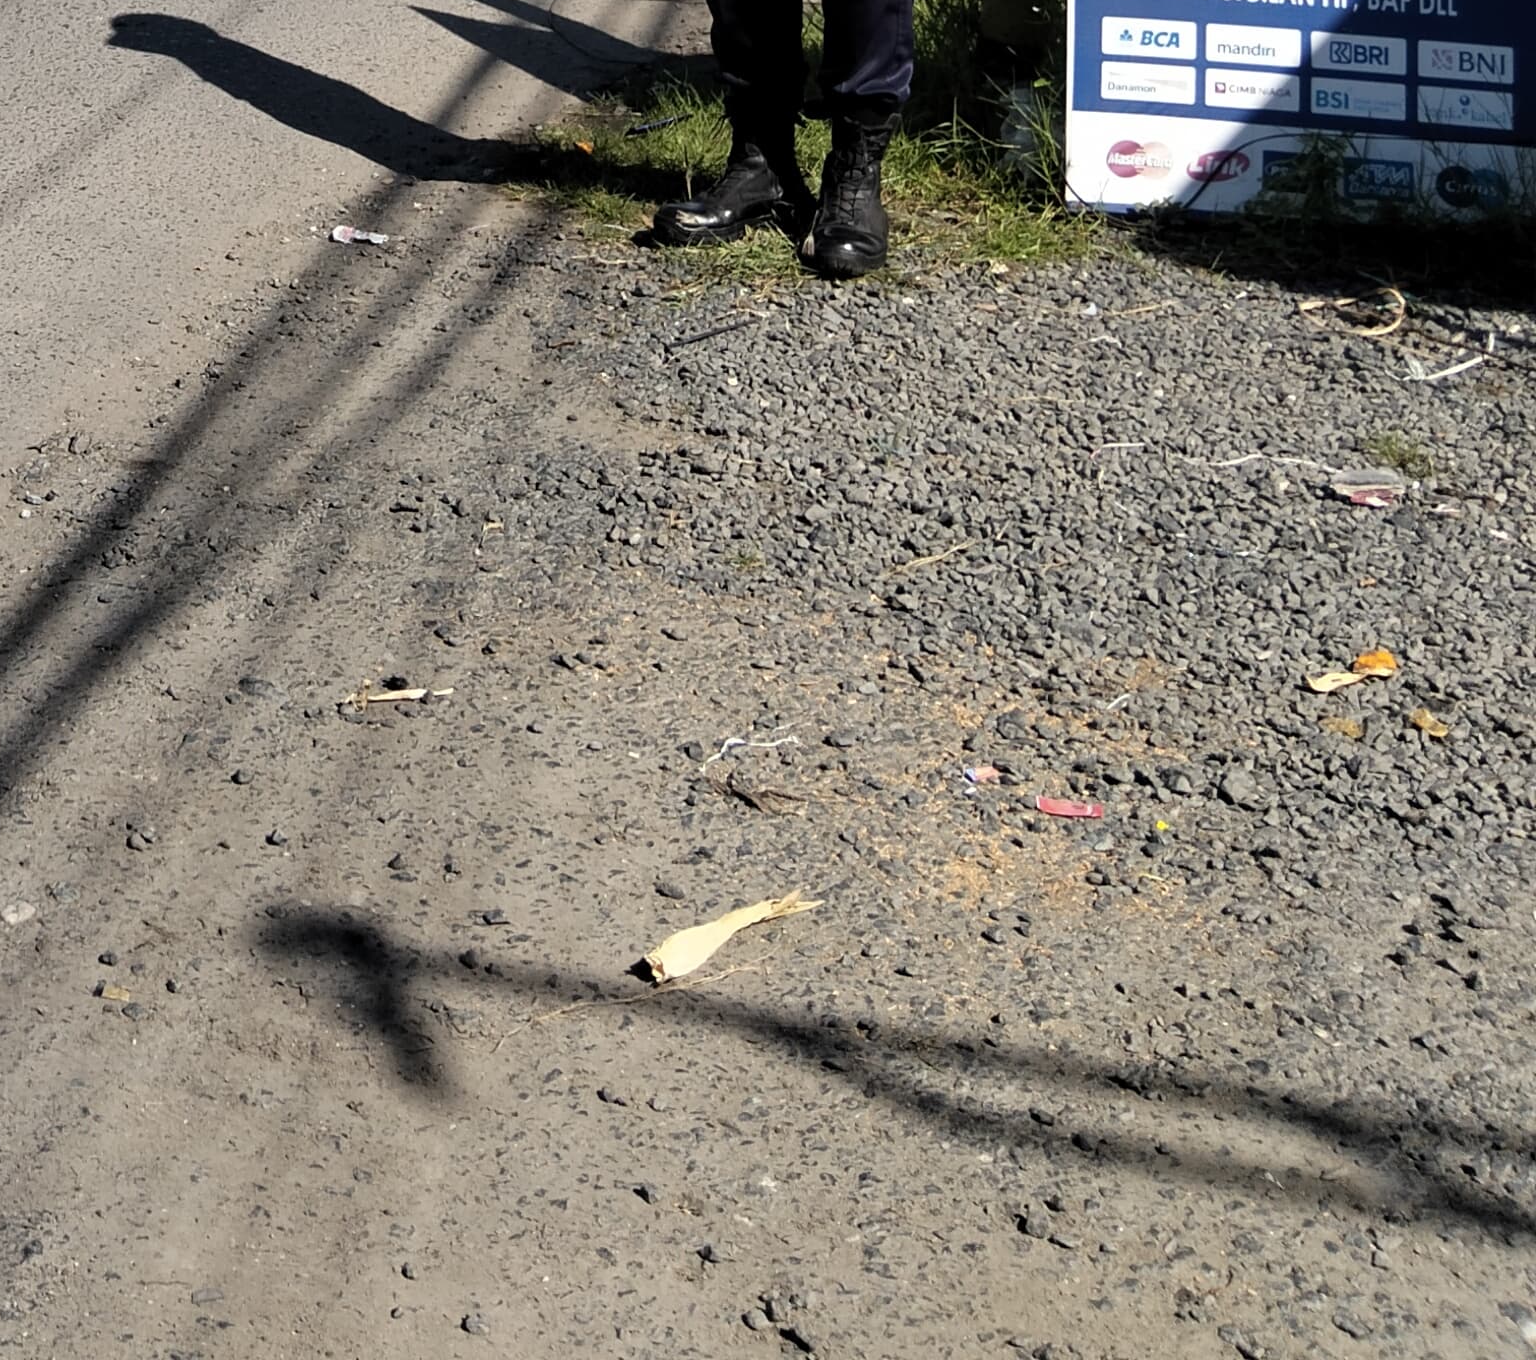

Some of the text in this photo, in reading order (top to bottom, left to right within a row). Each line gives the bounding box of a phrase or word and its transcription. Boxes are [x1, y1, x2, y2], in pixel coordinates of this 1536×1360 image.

[1140, 30, 1181, 49] BCA
[1217, 42, 1276, 58] mandiri
[1353, 45, 1389, 66] BRI
[1458, 51, 1506, 76] BNI
[1107, 82, 1156, 94] Danamon
[1229, 85, 1257, 95] CIMB
[1315, 90, 1350, 110] BSI
